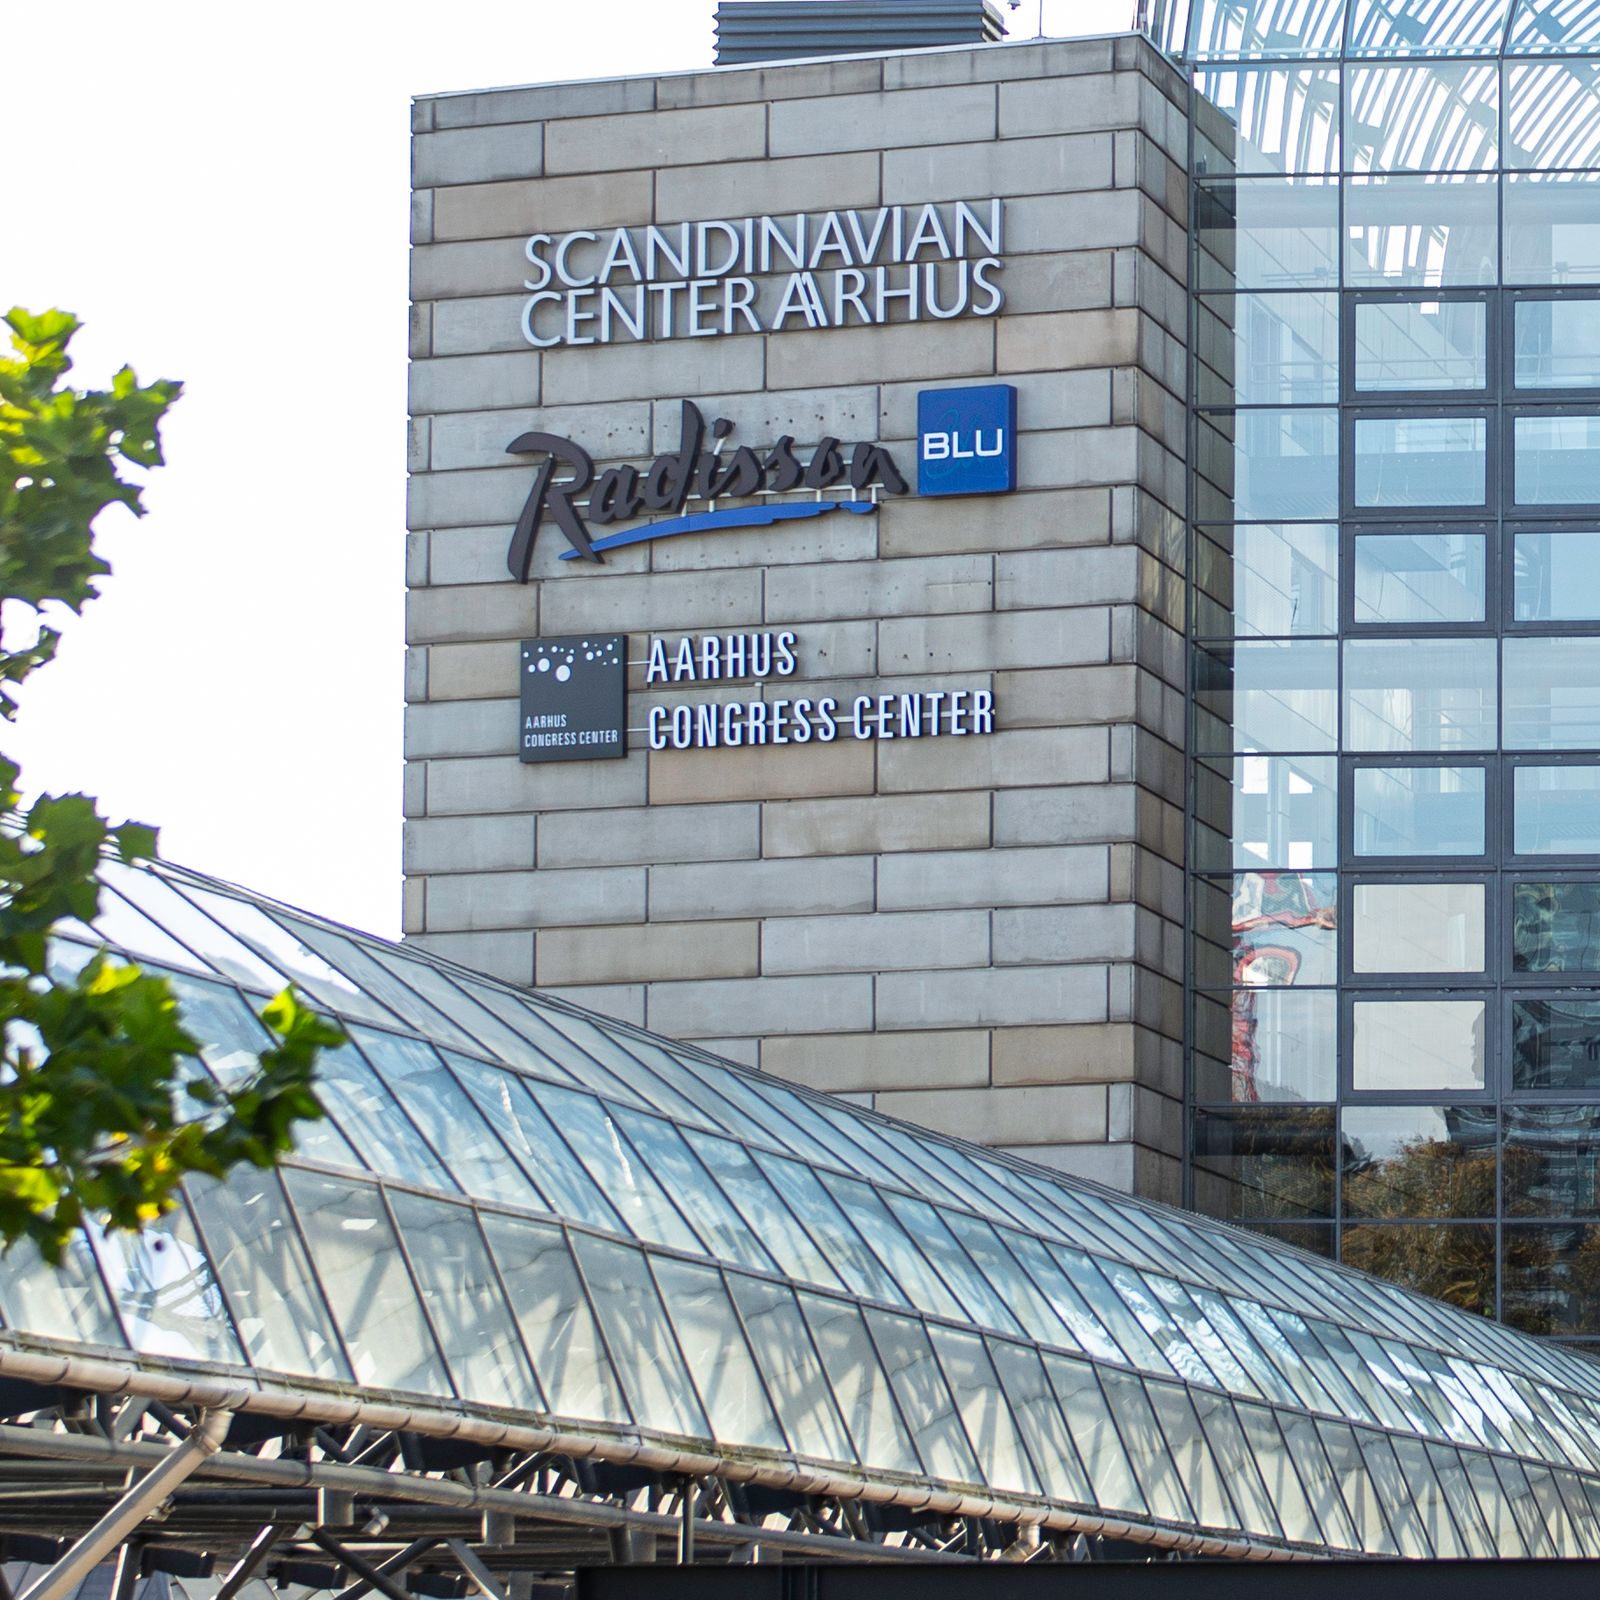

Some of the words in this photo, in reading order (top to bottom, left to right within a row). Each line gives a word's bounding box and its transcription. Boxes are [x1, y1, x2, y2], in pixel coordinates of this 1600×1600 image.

[523, 198, 1003, 291] SCANDINAVIAN
[520, 276, 762, 348] CENTER
[923, 427, 1004, 460] BLU
[505, 399, 909, 585] Radisson
[645, 631, 797, 684] AARHUS
[524, 731, 577, 748] CONGRESS
[579, 729, 618, 745] CENTER
[525, 714, 567, 729] AARHUS
[647, 697, 838, 750] CONGRESS
[852, 688, 995, 740] CENTER
